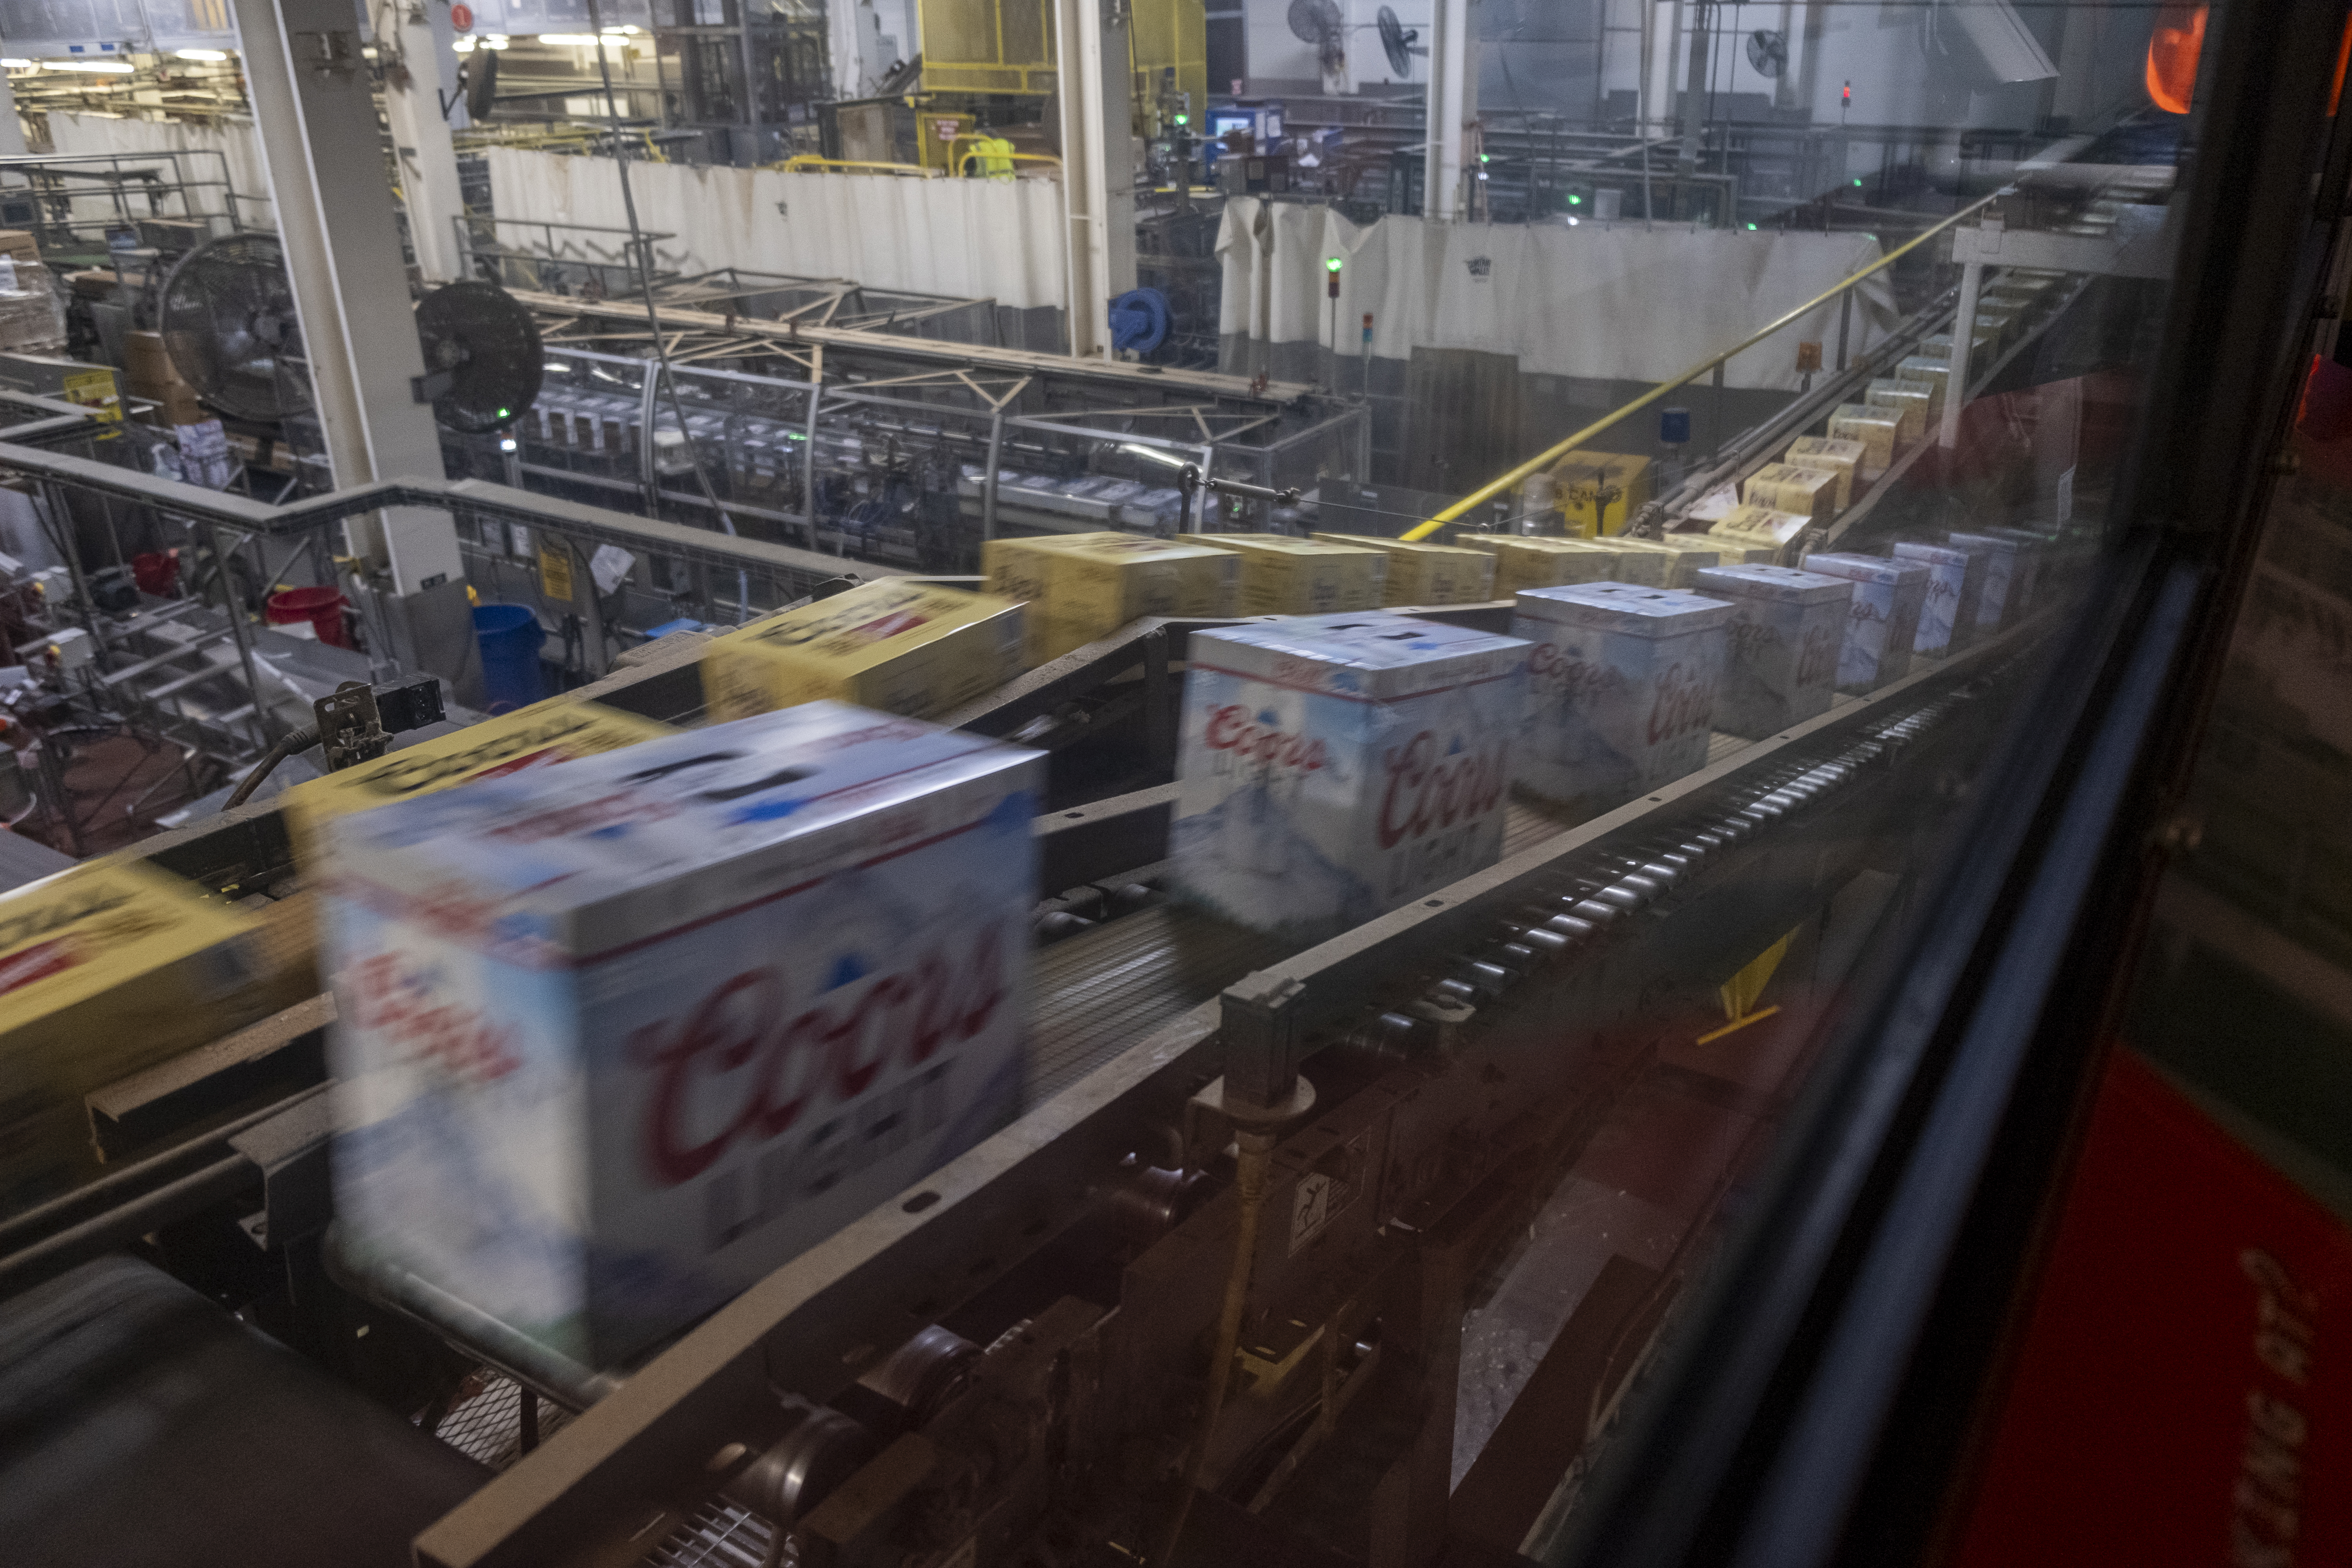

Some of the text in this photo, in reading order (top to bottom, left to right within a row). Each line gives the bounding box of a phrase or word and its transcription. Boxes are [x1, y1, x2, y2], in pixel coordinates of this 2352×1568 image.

[1204, 704, 1328, 771] Coors
[1378, 729, 1509, 850] Coors
[627, 917, 1004, 1188] Coors
